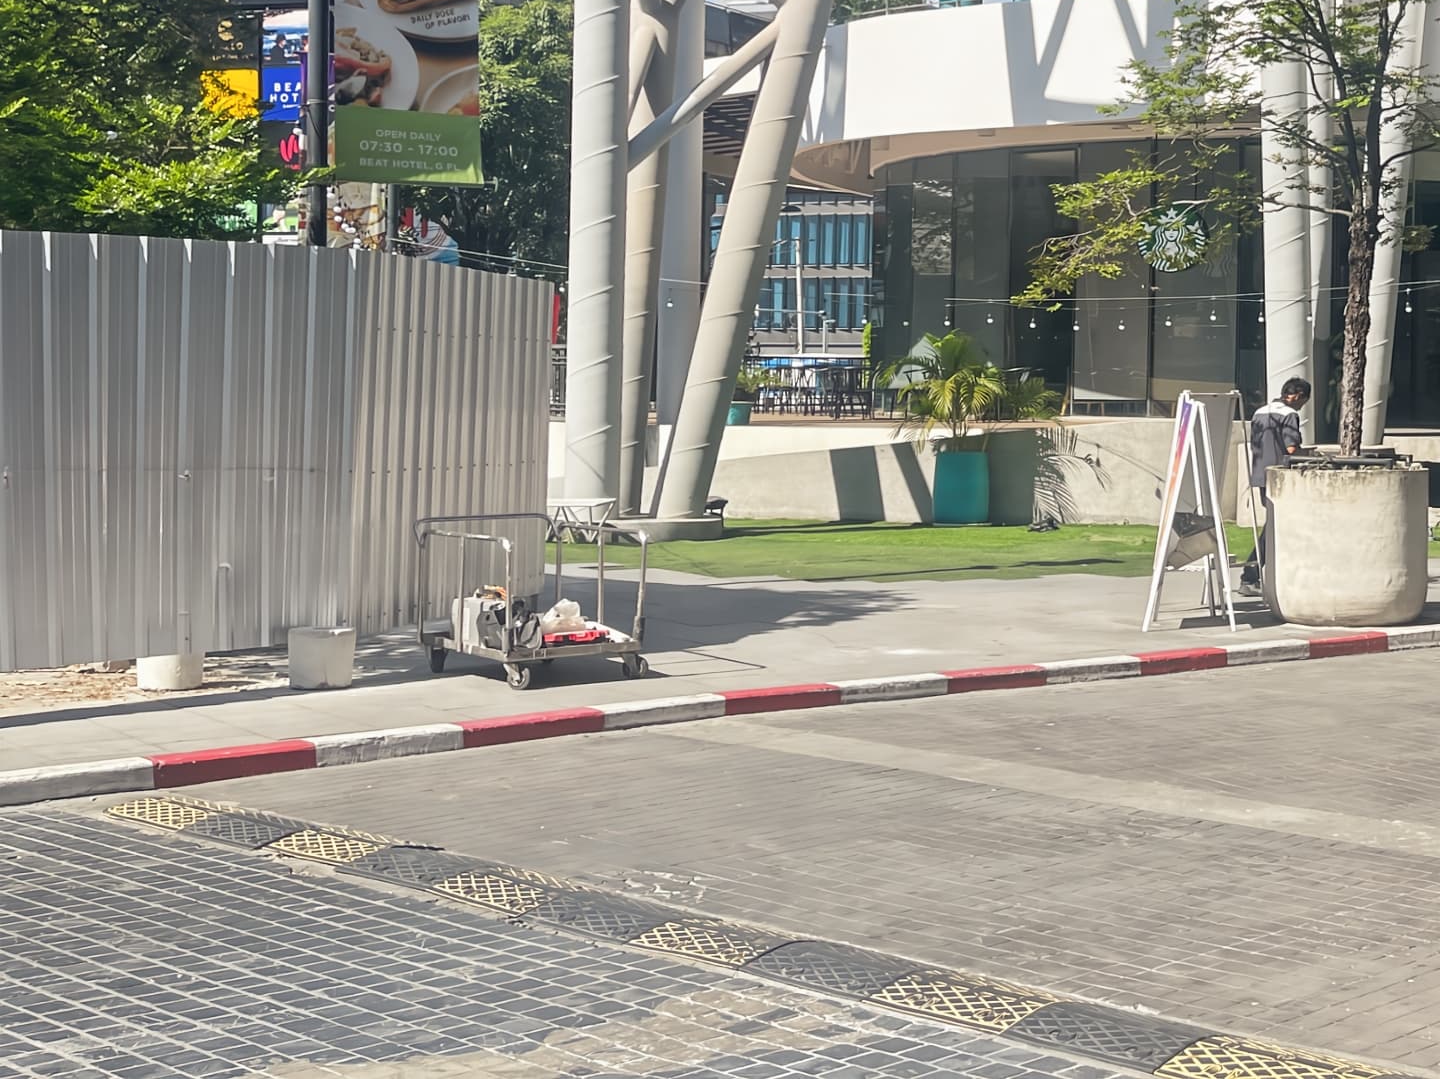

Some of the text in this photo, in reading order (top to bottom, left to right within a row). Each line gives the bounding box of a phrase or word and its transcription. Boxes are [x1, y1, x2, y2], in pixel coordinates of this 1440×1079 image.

[274, 82, 301, 92] BEA
[269, 93, 299, 103] HOT
[375, 129, 441, 142] OPEN DAILY
[360, 140, 402, 153] 07:30
[418, 145, 458, 157] 17:00
[360, 158, 388, 168] BEAT
